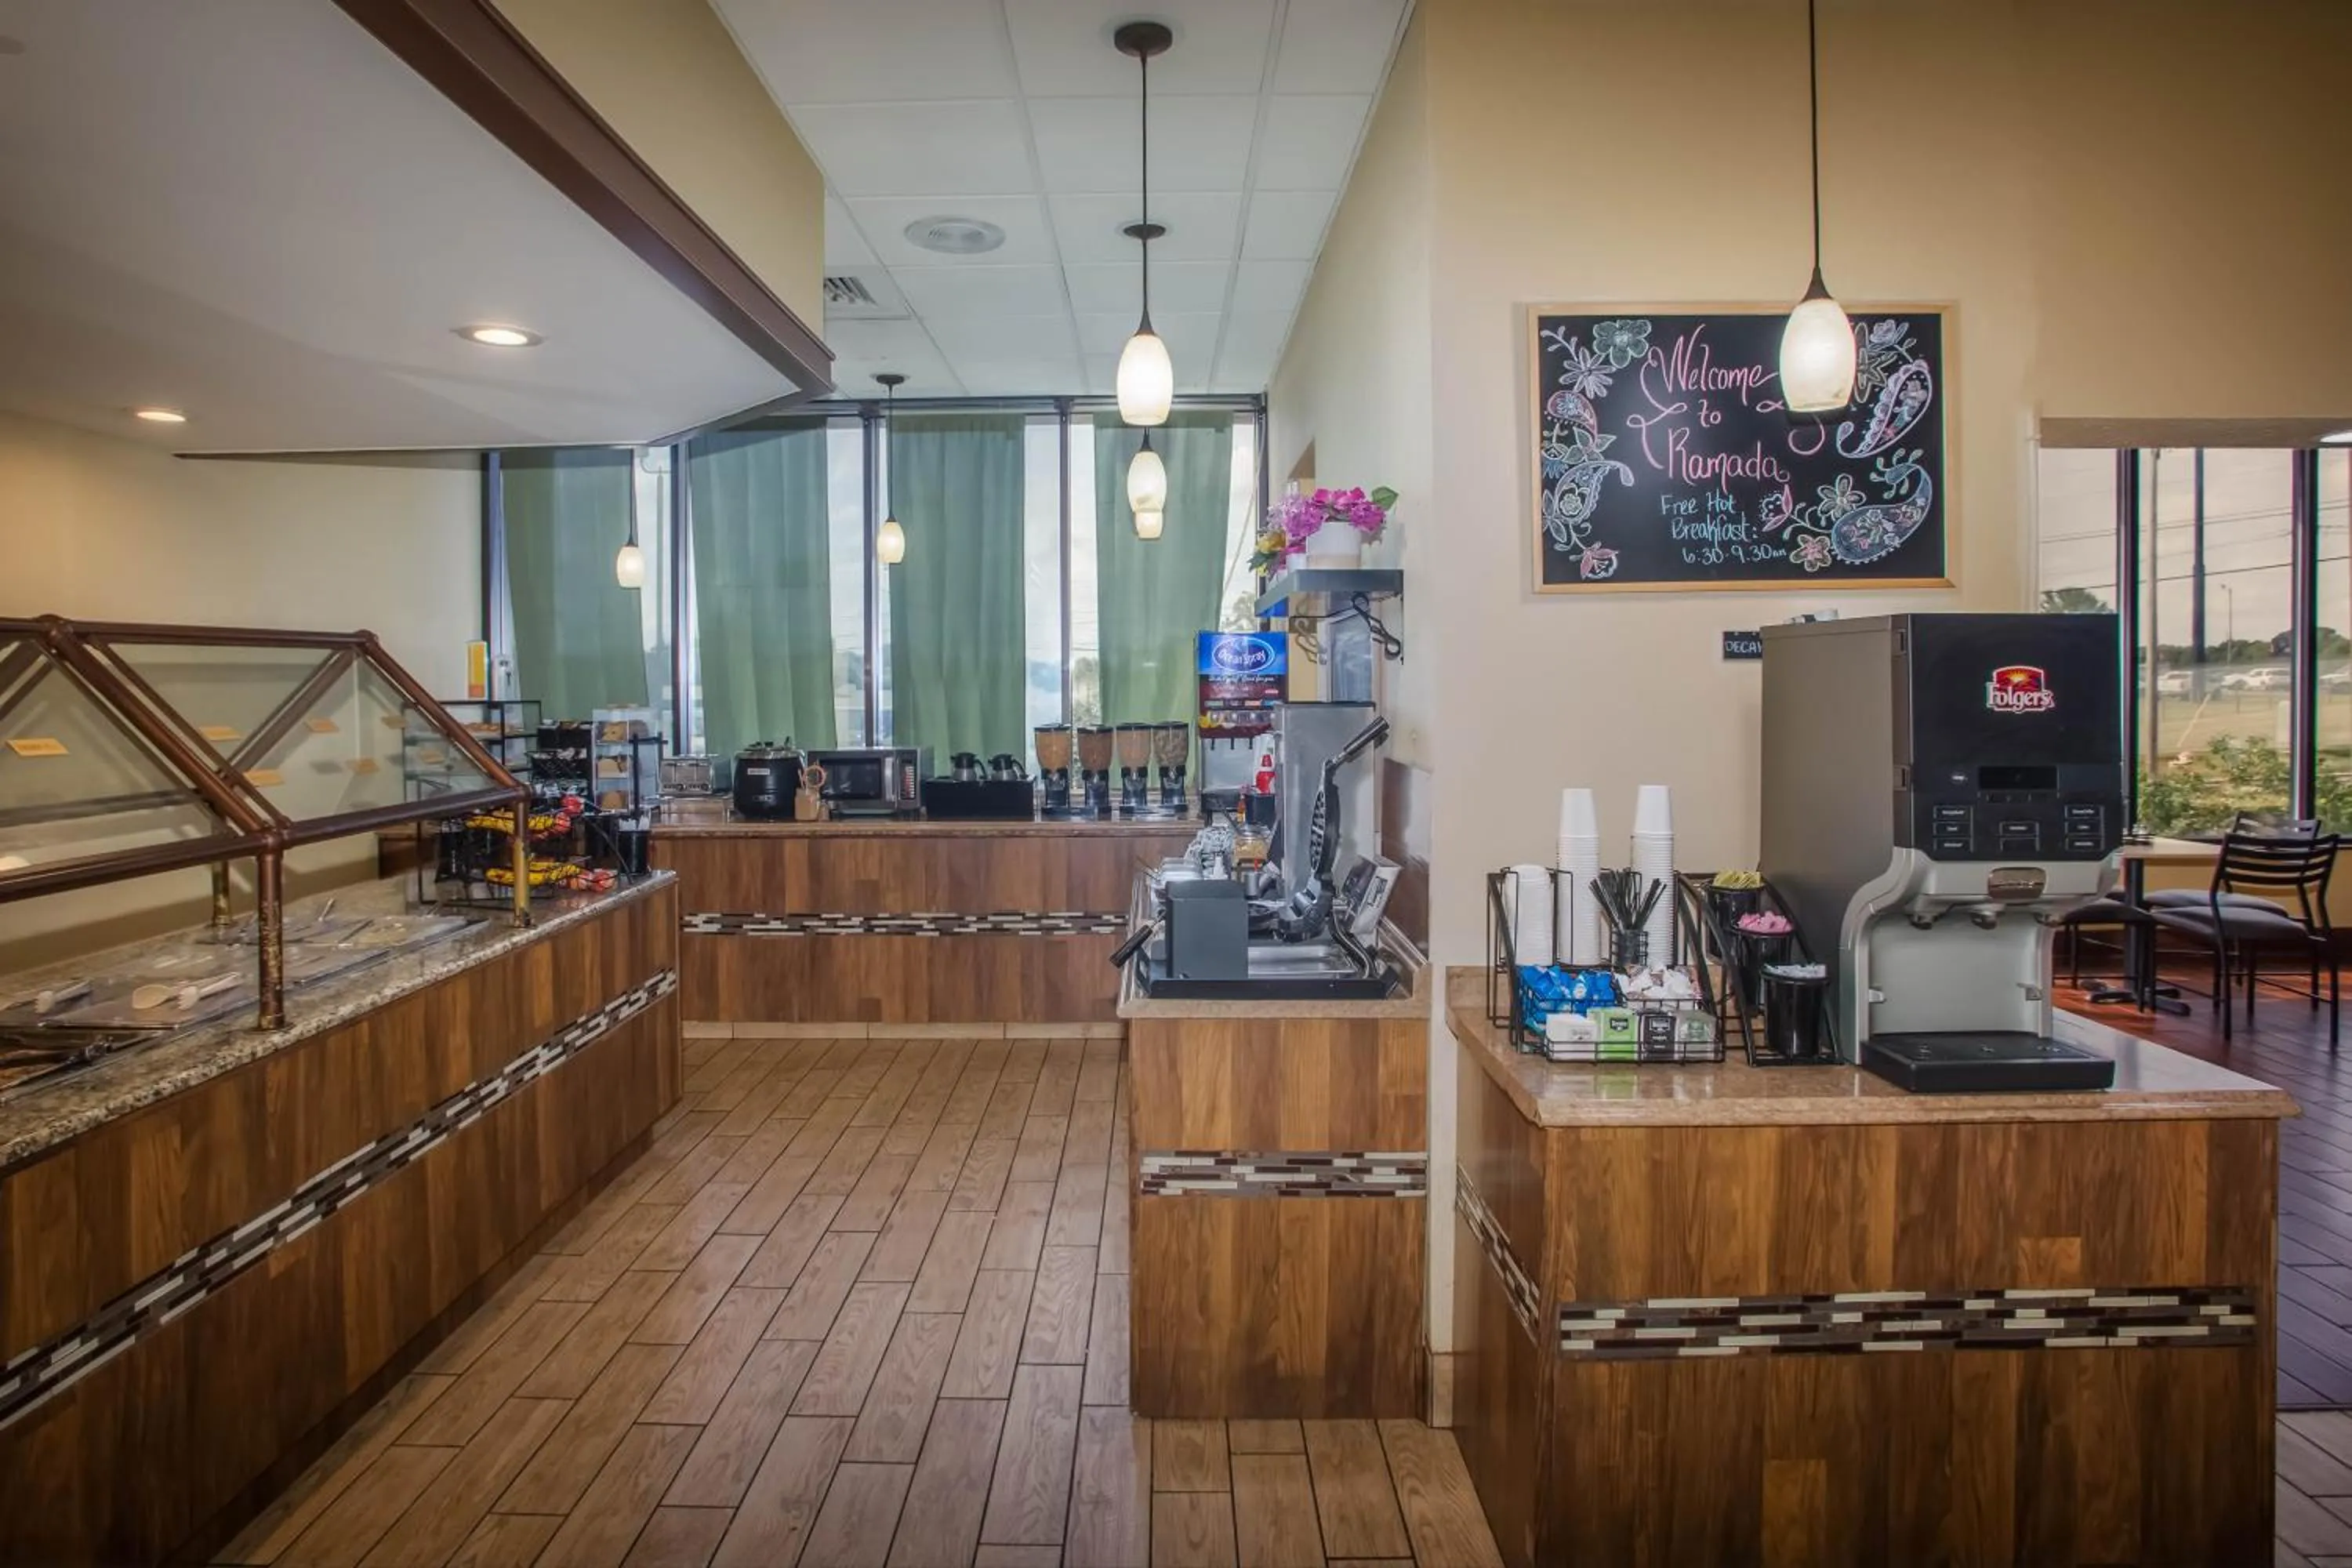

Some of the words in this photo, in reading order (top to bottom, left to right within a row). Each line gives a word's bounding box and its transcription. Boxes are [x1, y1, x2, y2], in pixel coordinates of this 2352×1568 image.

[1646, 324, 1778, 406] Welcome
[1698, 400, 1722, 427] to
[1668, 427, 1791, 494] Ramada
[1661, 494, 1698, 515] Free
[1706, 488, 1737, 514] Hot
[1671, 510, 1759, 547] Breakfast:
[1987, 682, 2054, 713] Folgers
